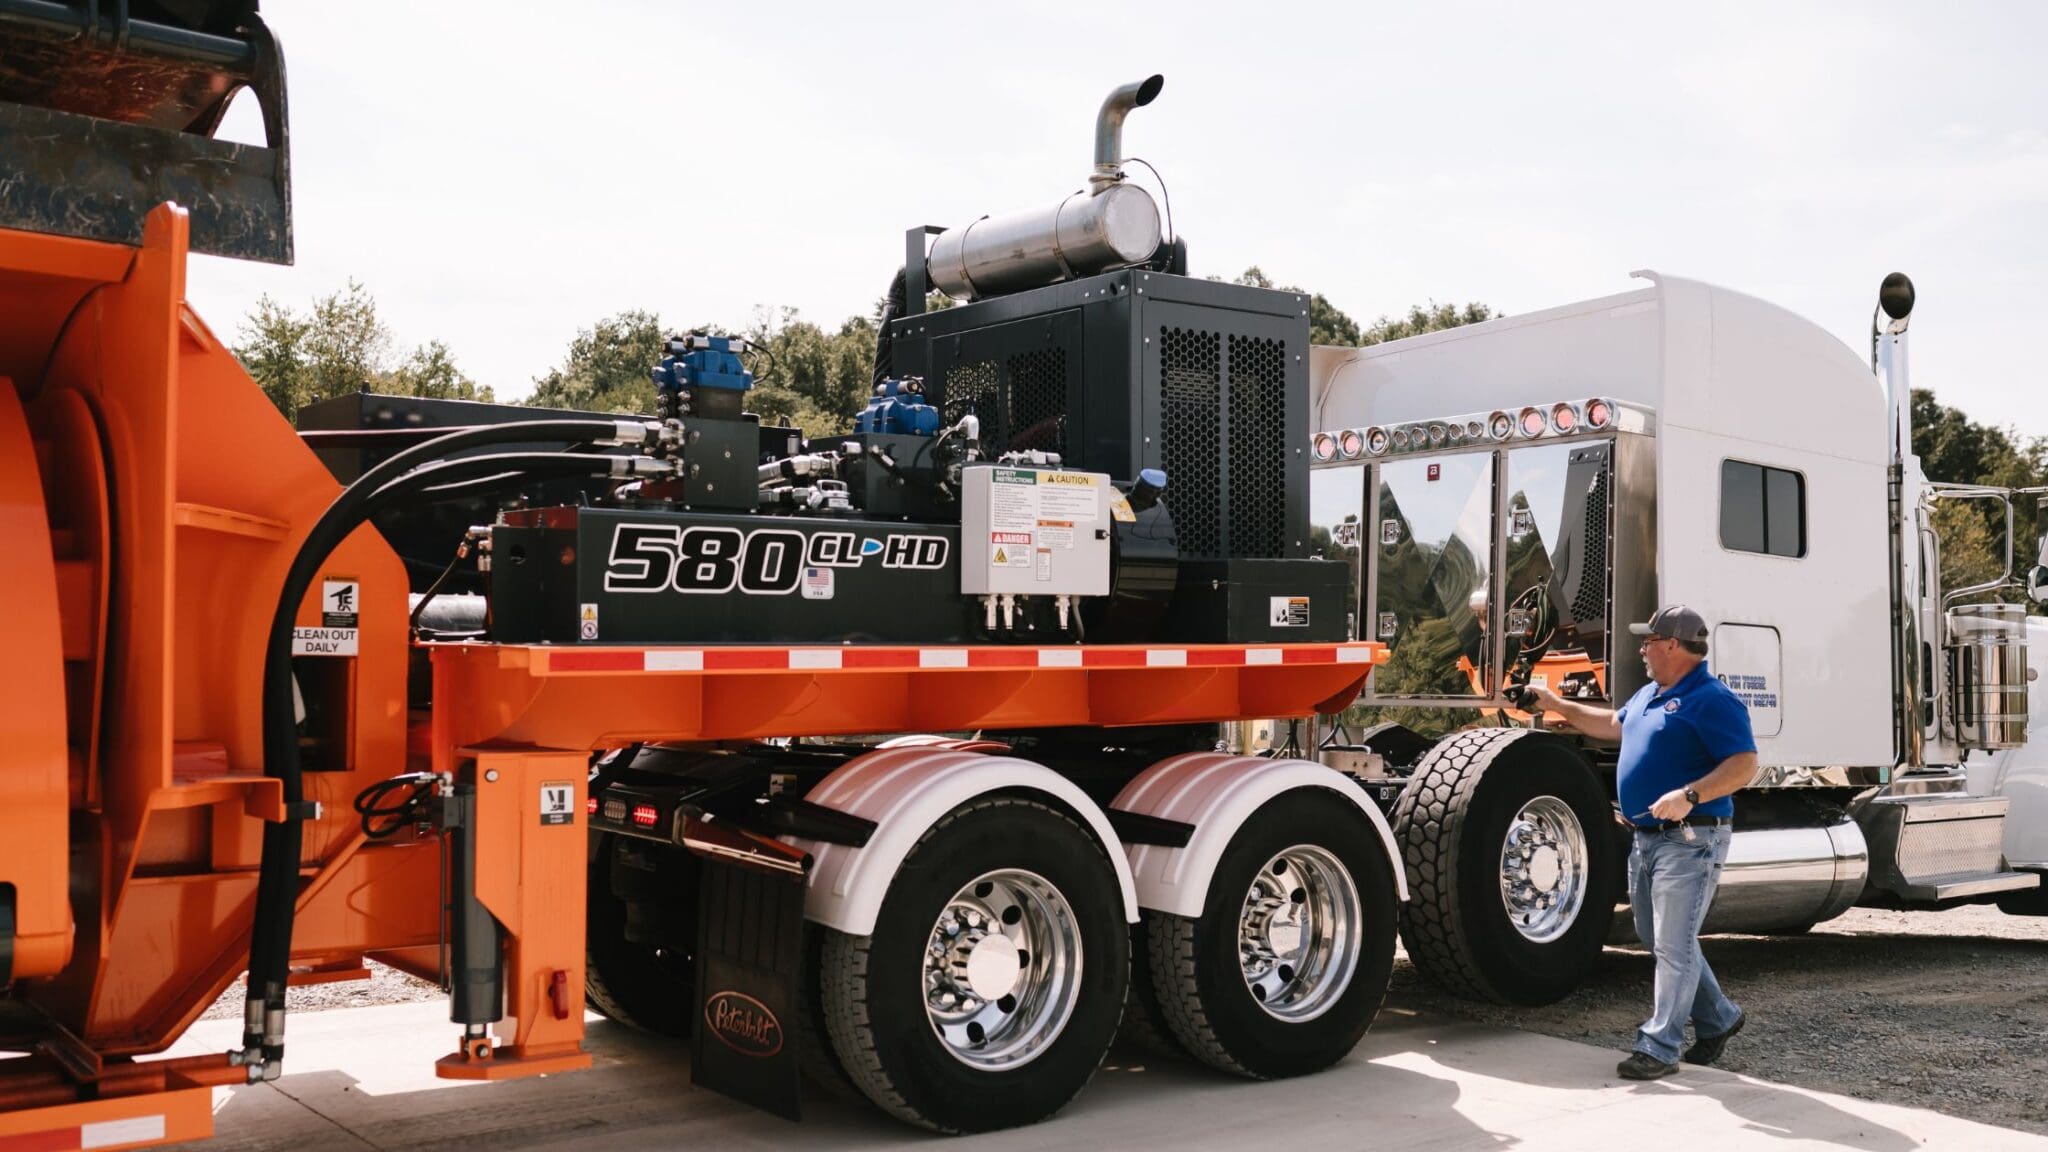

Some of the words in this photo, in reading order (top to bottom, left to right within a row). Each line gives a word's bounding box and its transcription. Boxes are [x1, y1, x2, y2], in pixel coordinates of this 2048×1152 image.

[996, 469, 1017, 477] SAFETY
[995, 476, 1034, 484] INSTRUCTIONS
[1056, 474, 1089, 484] CAUTION
[1002, 533, 1029, 544] DANGER
[604, 523, 807, 595] 580
[291, 629, 328, 640] CLEAN
[331, 630, 356, 640] OUT
[305, 642, 339, 652] DAILY
[716, 999, 774, 1045] Peterbilt
